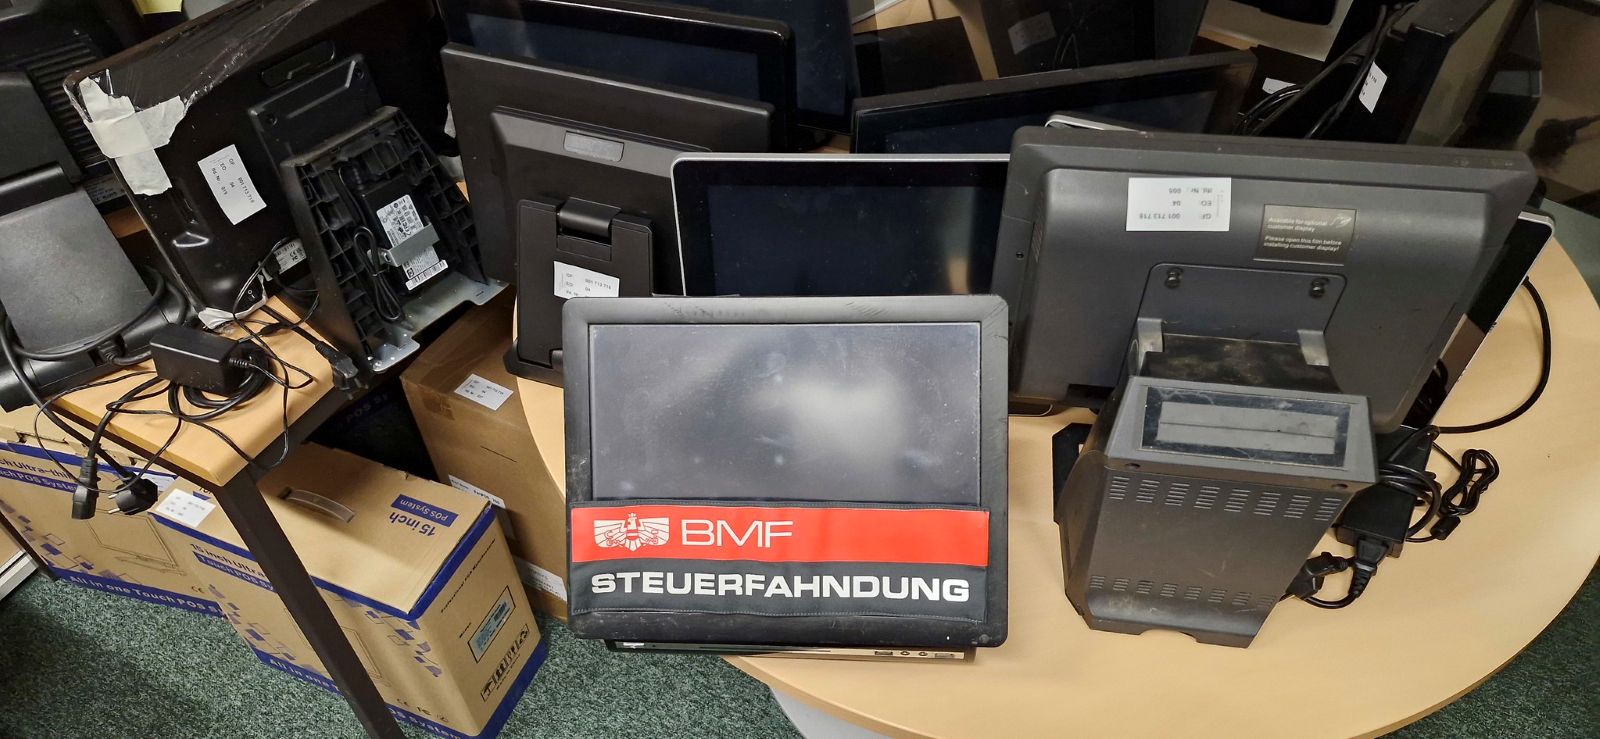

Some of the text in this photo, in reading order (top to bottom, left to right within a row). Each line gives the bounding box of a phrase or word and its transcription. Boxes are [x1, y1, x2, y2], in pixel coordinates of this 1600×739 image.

[389, 512, 436, 536] 15 inch
[400, 499, 449, 521] POS System
[680, 519, 794, 548] BMF
[69, 575, 88, 586] All
[89, 579, 103, 588] in
[106, 584, 131, 594] one
[130, 589, 175, 603] Touch
[177, 597, 207, 610] POS
[591, 571, 970, 602] STEUERFAHNDUNG
